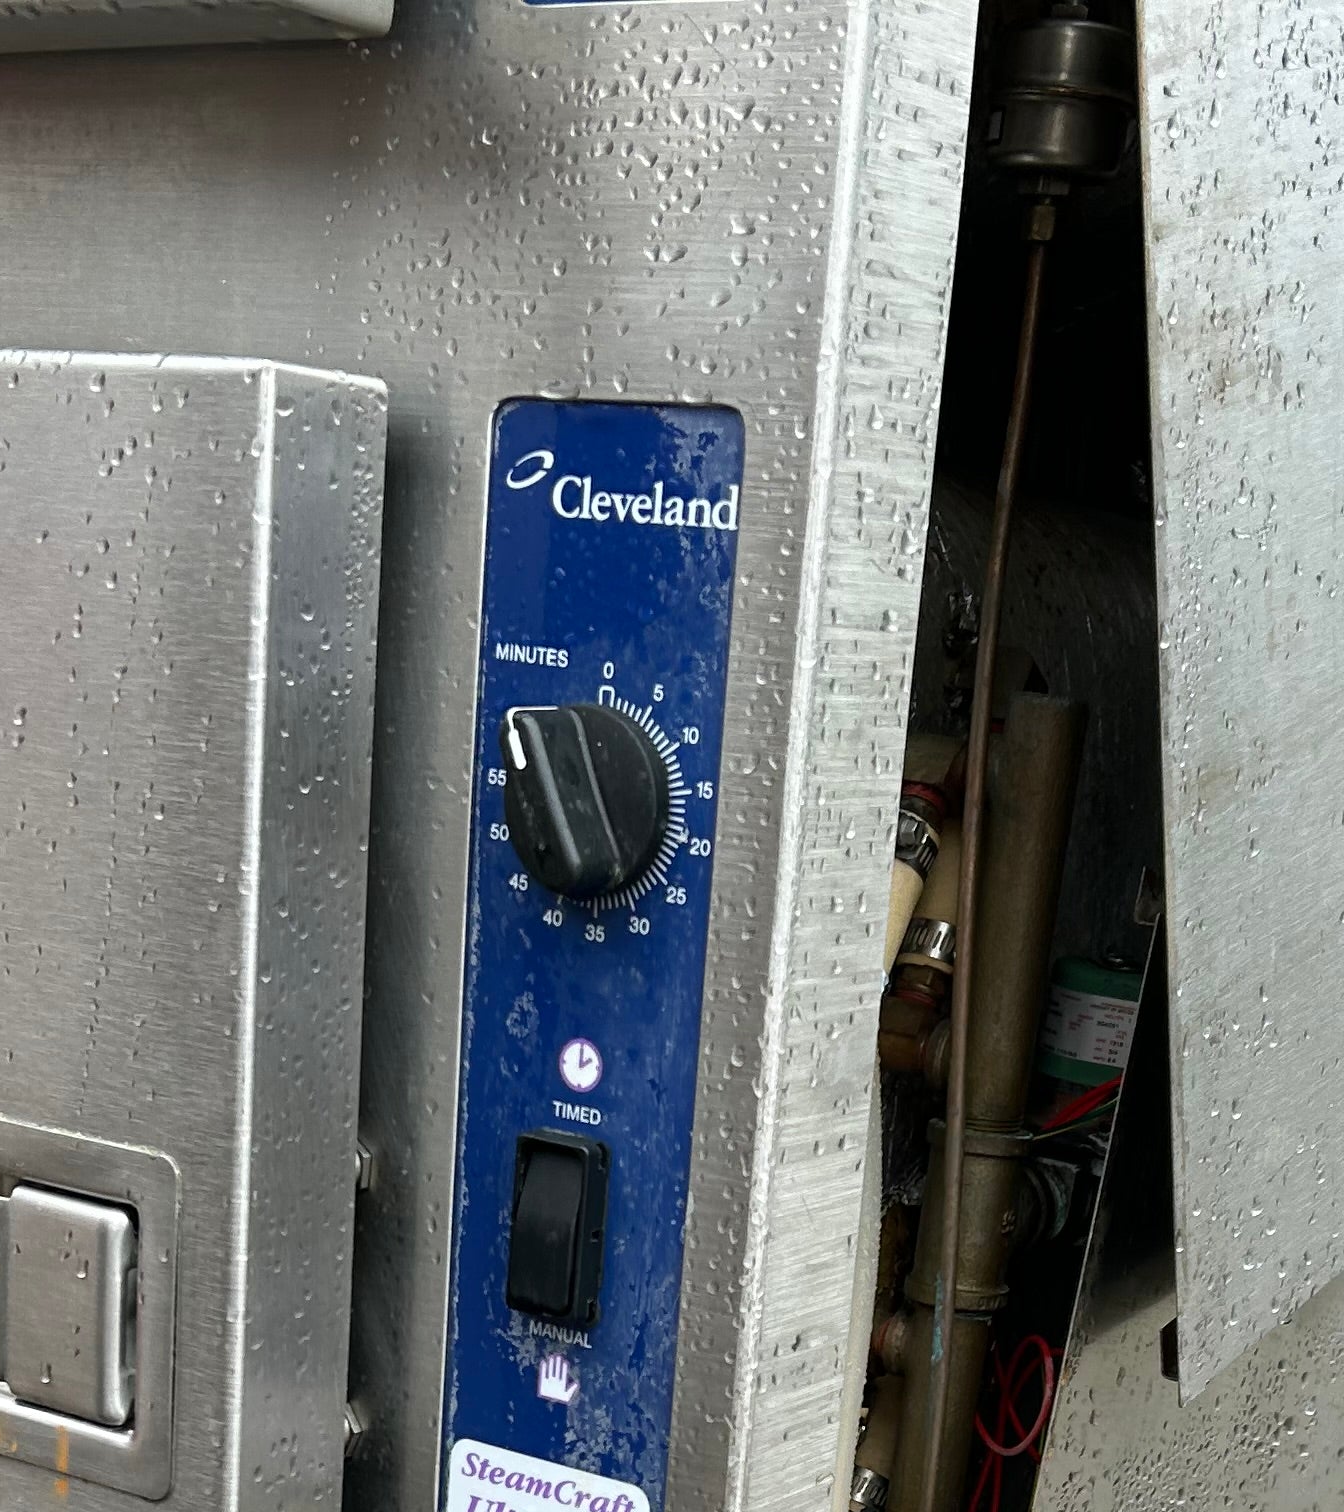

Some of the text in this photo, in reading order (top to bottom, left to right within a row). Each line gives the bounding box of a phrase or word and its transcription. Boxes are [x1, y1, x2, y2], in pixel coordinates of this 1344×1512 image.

[552, 475, 740, 531] Cleveland
[495, 643, 569, 668] MINUTES
[603, 662, 615, 680] 0
[653, 684, 665, 702] 5
[682, 727, 700, 744] 10
[487, 768, 507, 787] 55
[696, 781, 714, 799] 15
[489, 823, 510, 841] 50
[689, 838, 711, 857] 20
[508, 873, 529, 891] 45
[665, 886, 688, 905] 25
[543, 908, 563, 927] 40
[629, 917, 650, 935] 30
[585, 924, 606, 943] 35
[552, 1100, 602, 1126] TIMED
[529, 1320, 593, 1350] MANUAL
